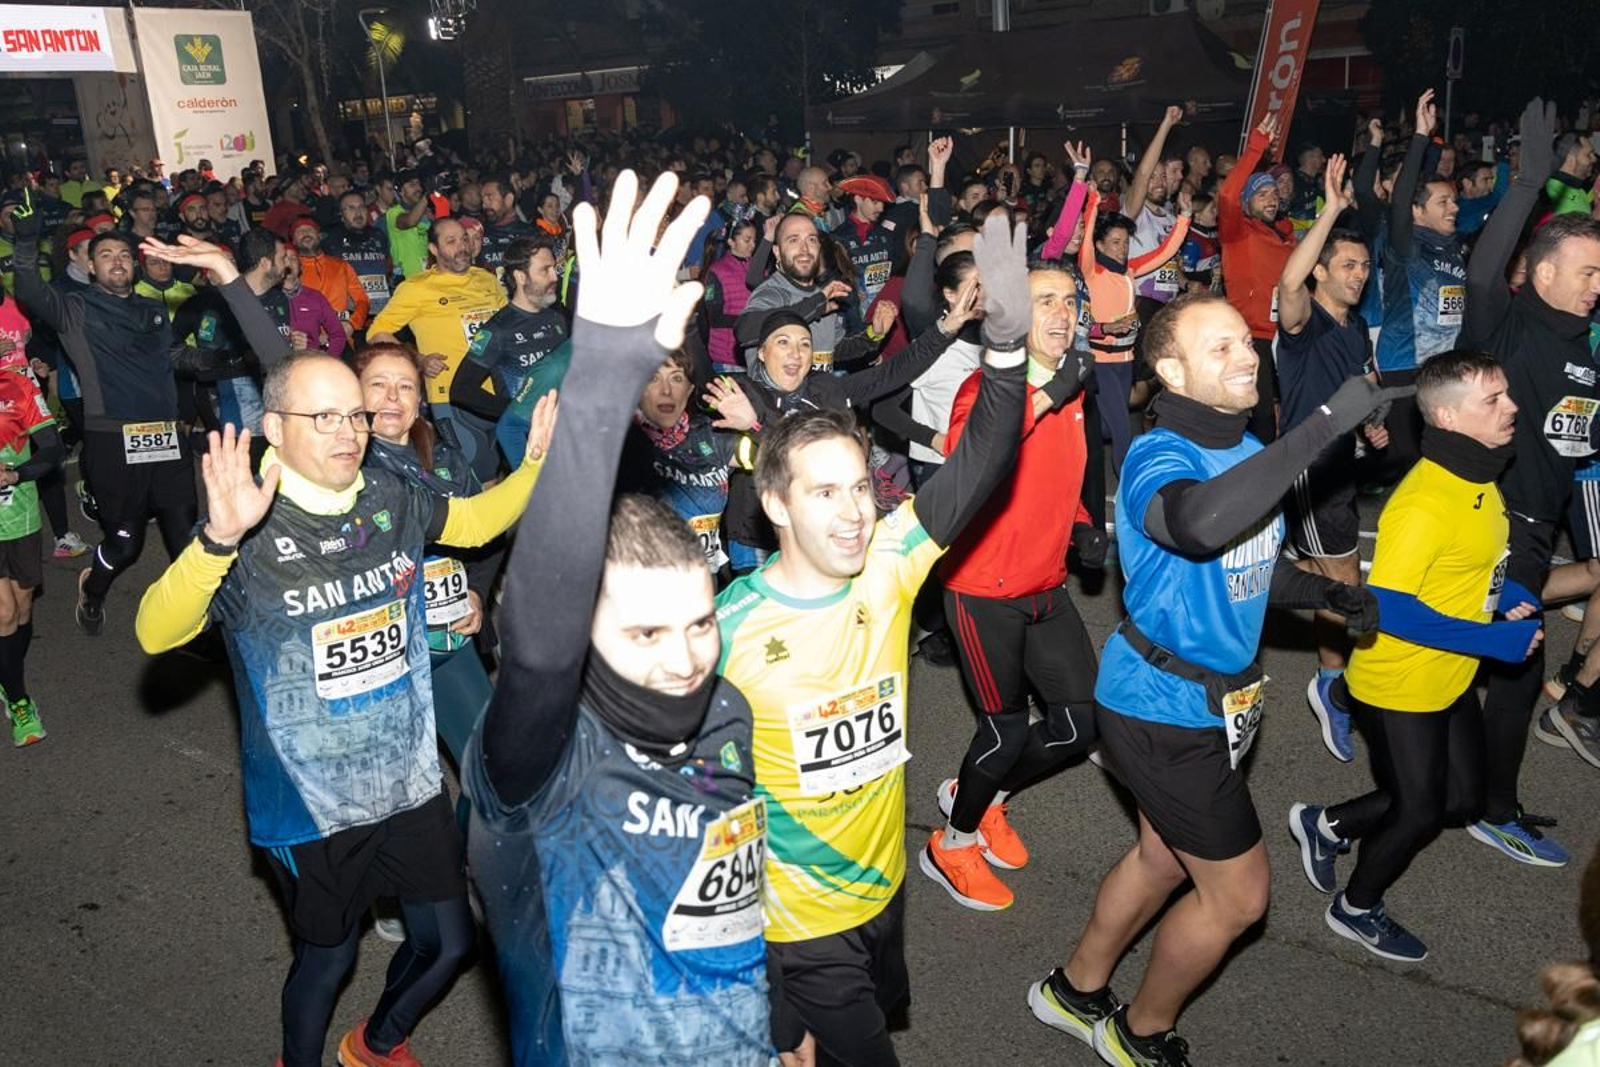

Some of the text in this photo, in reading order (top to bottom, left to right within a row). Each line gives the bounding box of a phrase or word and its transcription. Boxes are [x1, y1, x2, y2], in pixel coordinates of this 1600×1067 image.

[3, 28, 42, 52] SAN
[1551, 412, 1588, 435] 6768
[130, 432, 173, 448] 5587
[653, 461, 687, 485] SAN
[283, 580, 347, 616] SAN
[353, 551, 416, 600] ANTÓN
[337, 620, 356, 635] 42
[326, 624, 402, 669] 5539
[819, 700, 839, 718] 42
[805, 702, 895, 759] 7076
[622, 791, 706, 838] SAN
